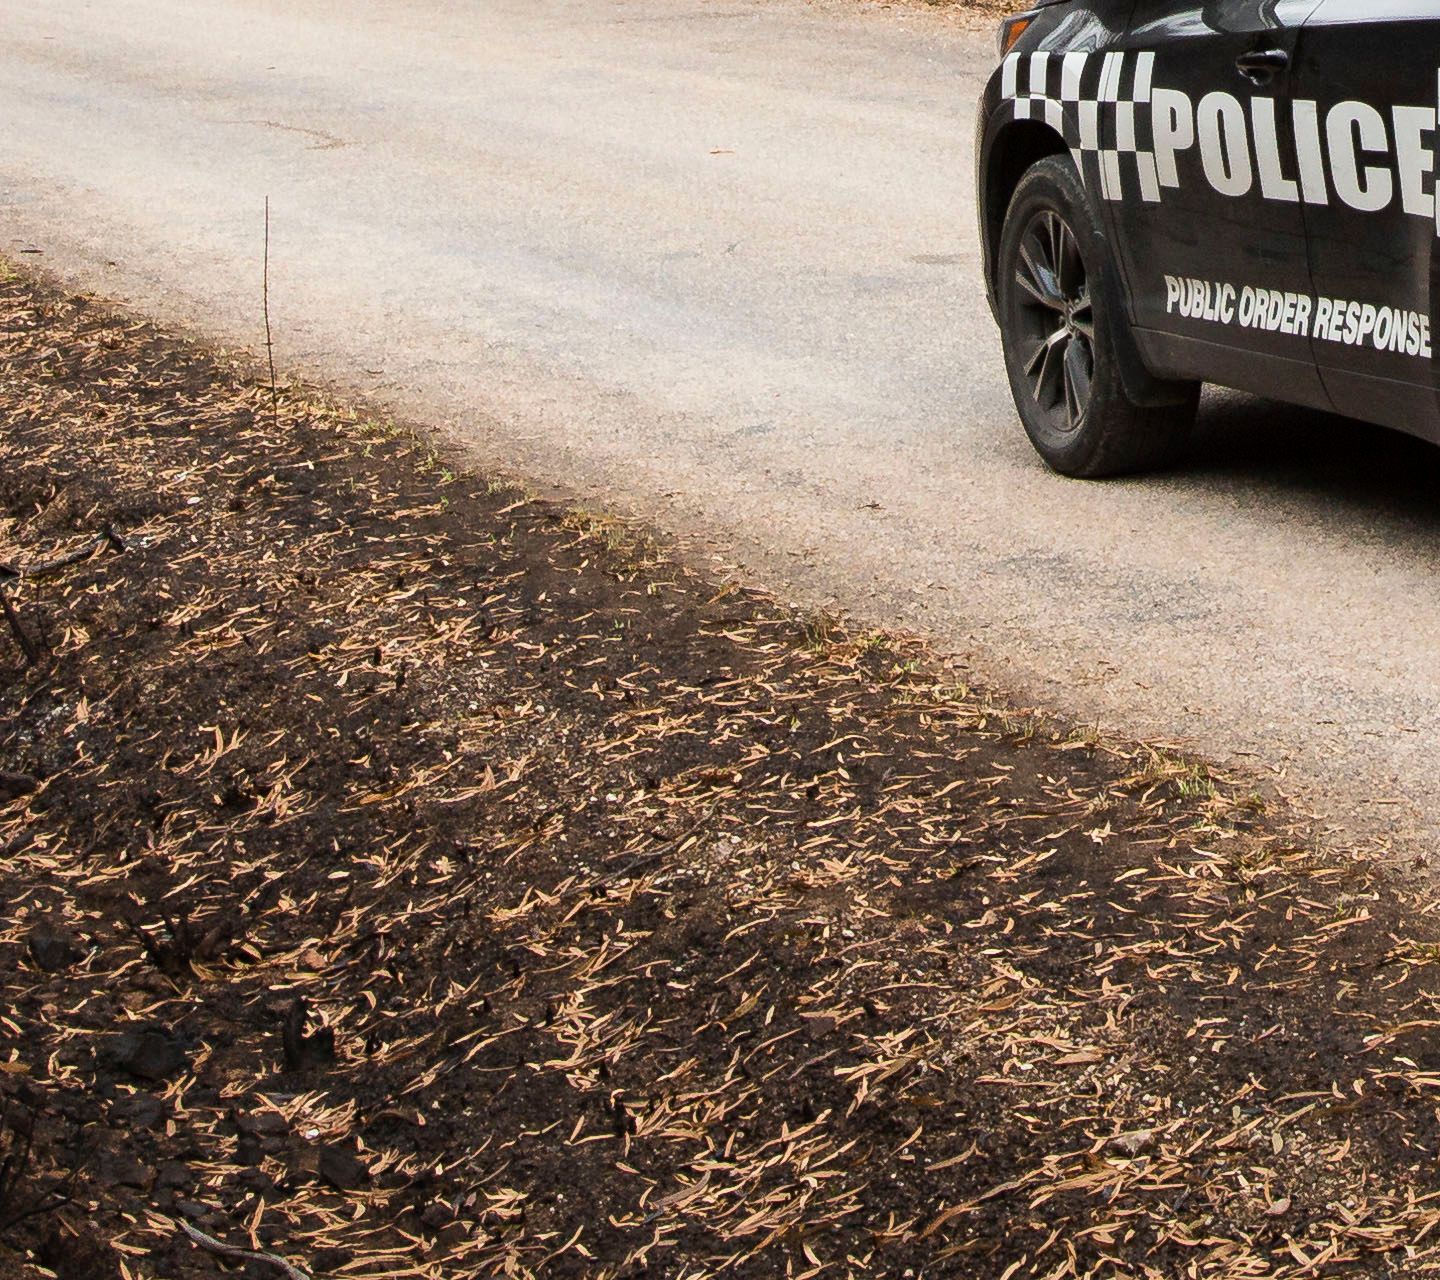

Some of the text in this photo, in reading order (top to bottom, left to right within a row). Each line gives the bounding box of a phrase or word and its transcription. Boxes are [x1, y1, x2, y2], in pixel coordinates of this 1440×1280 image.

[1152, 88, 1436, 218] POLICE
[1164, 274, 1433, 359] PUBLIC ORDER RESPONSE
